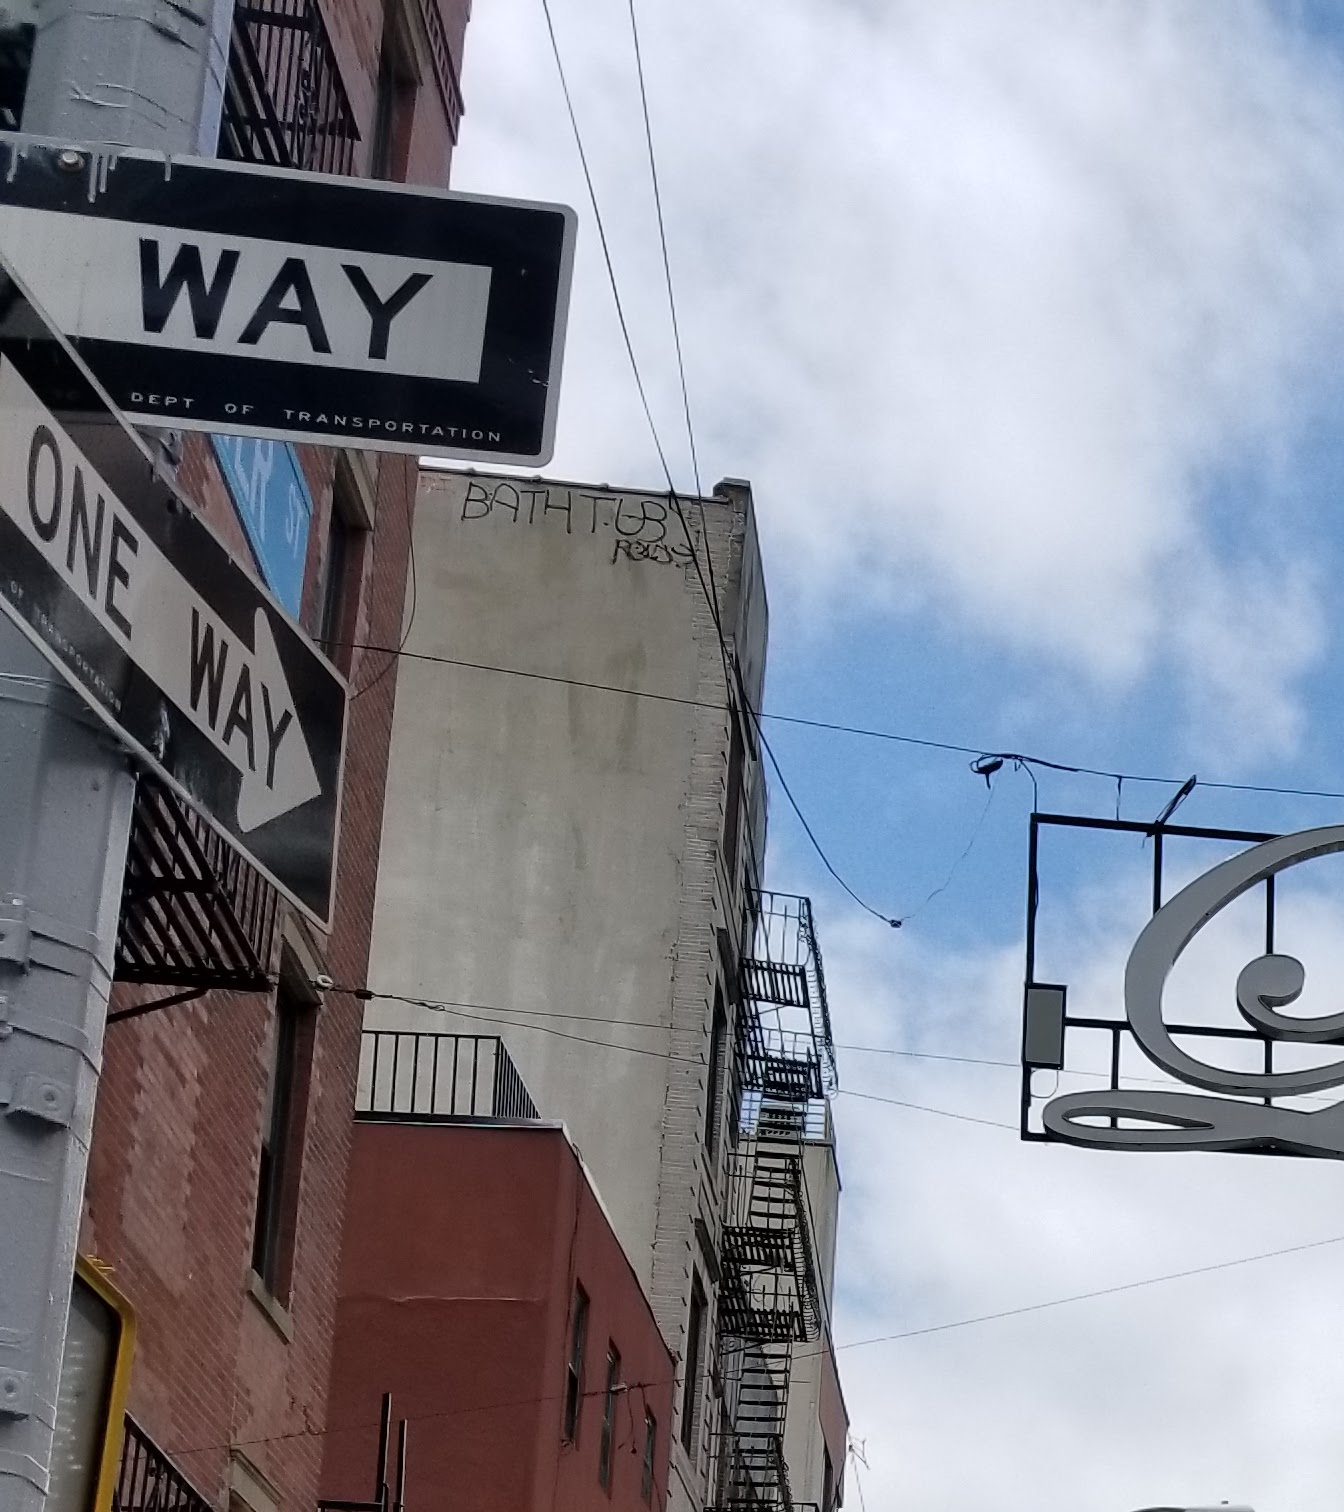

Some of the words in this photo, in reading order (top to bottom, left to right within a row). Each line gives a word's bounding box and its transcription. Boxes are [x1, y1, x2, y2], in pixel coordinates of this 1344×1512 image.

[139, 237, 433, 360] WAY
[131, 392, 195, 409] DEPT
[225, 403, 254, 414] OF
[284, 409, 502, 443] TRANSPORTATION
[28, 424, 139, 641] ONE
[189, 606, 293, 790] WAY
